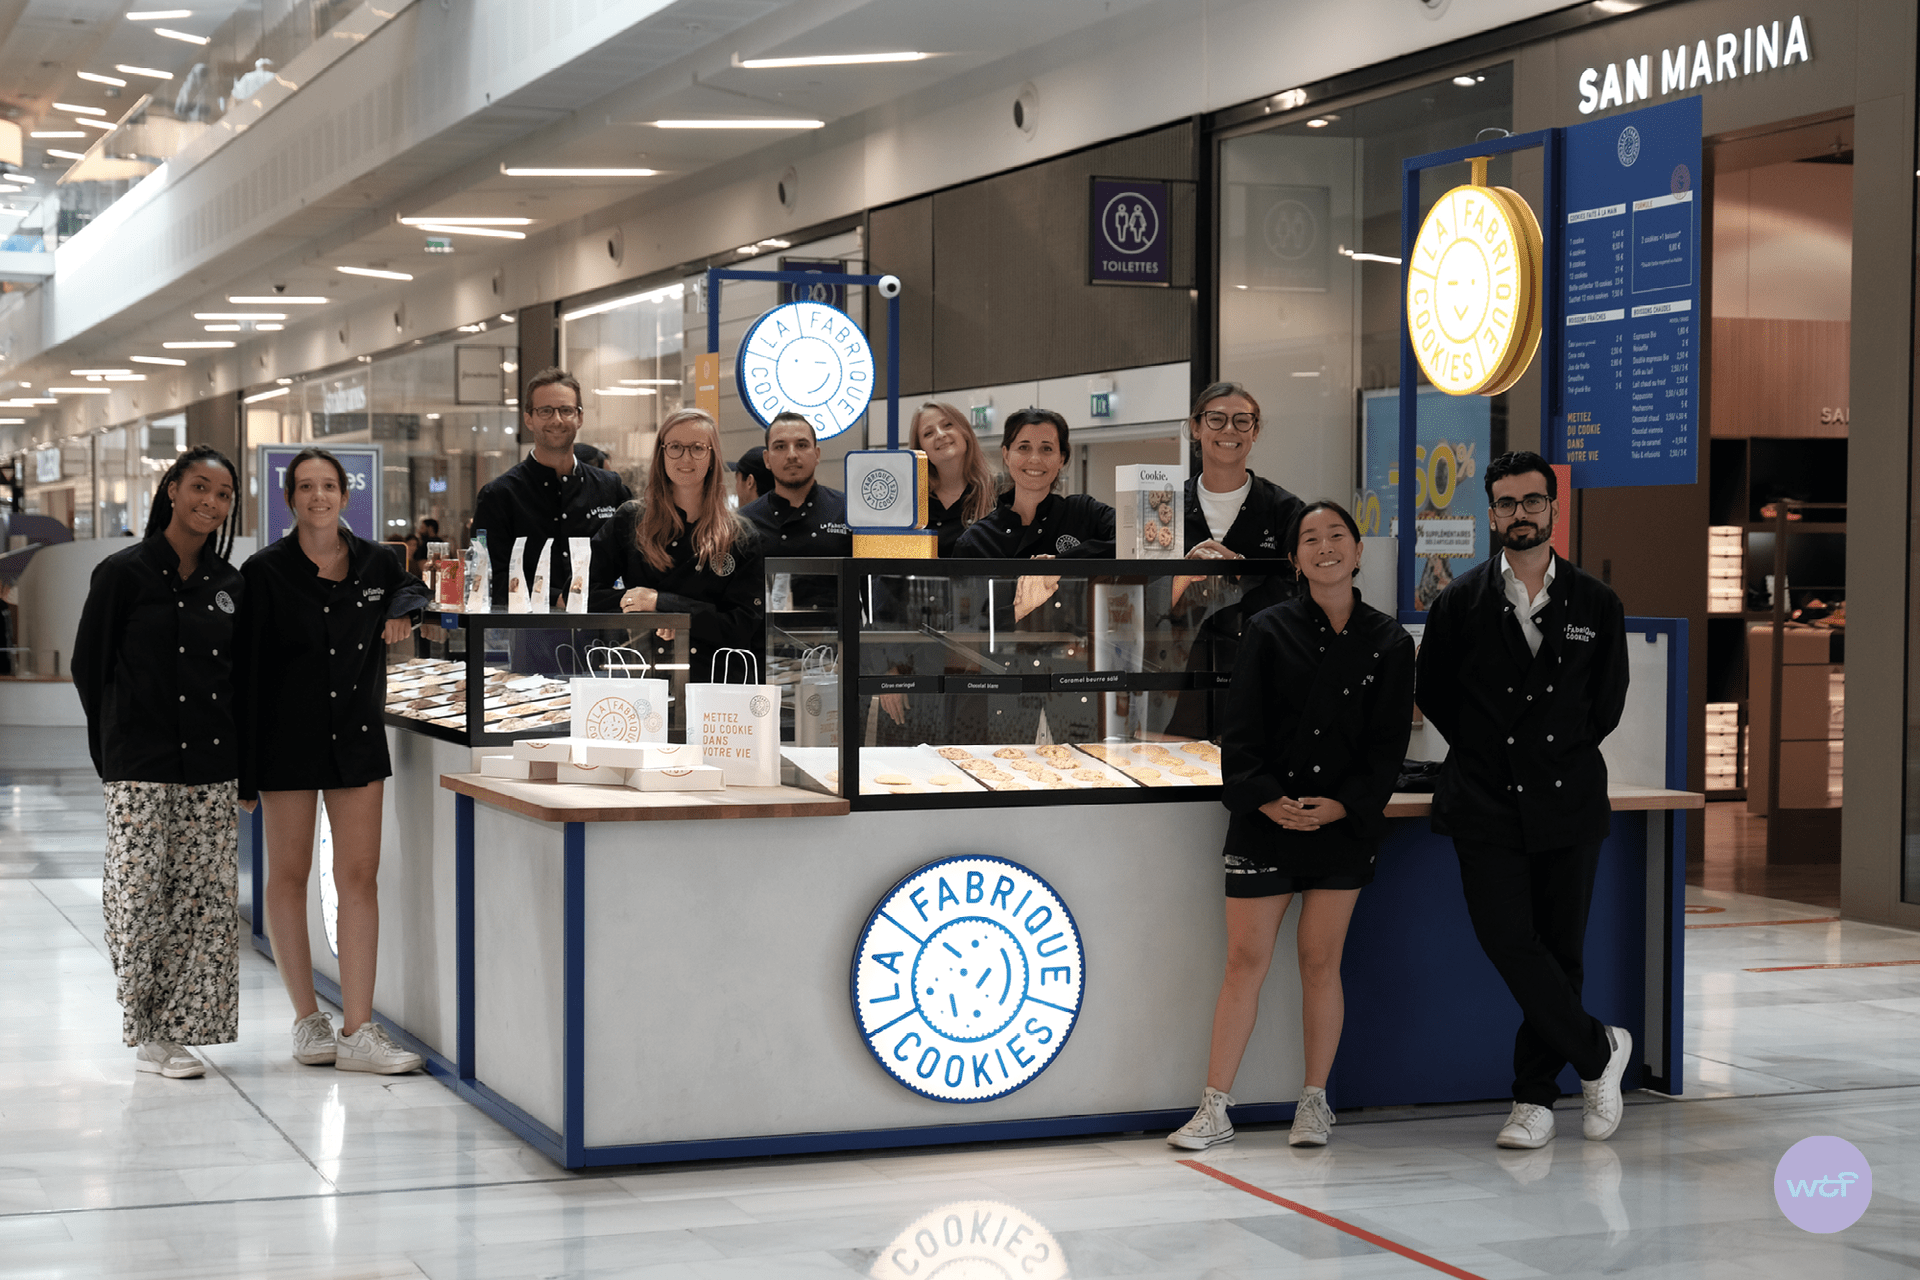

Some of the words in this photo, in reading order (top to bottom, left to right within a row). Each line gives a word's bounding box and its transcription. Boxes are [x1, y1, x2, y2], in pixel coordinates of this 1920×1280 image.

[1578, 54, 1650, 115] SAN
[1661, 15, 1809, 96] MARINA
[1423, 218, 1449, 260] LA
[1102, 260, 1159, 273] TOILETTES
[1464, 199, 1512, 354] FABRIQUE
[760, 320, 790, 349] LA
[1414, 288, 1473, 382] COOKIES
[811, 311, 867, 416] FABRIQUE
[752, 367, 825, 432] COOS
[1567, 411, 1592, 423] METTEZ
[1577, 423, 1601, 435] COOKIE
[1567, 437, 1584, 450] DANS
[1567, 450, 1587, 463] VOTRE
[1588, 450, 1599, 461] VIE
[864, 472, 891, 491] FABRIQUE
[1140, 470, 1168, 481] Cookie.
[1086, 676, 1106, 684] beurre
[592, 705, 606, 719] LA
[703, 713, 738, 723] METTEZ
[703, 724, 716, 734] DU
[719, 725, 753, 735] COOKIE
[703, 735, 728, 745] DANS
[702, 747, 731, 758] VOTRE
[736, 748, 751, 758] VIE
[909, 871, 1071, 986] FABRIQUE
[869, 951, 904, 1004] LA
[894, 1017, 1053, 1088] COOKIES
